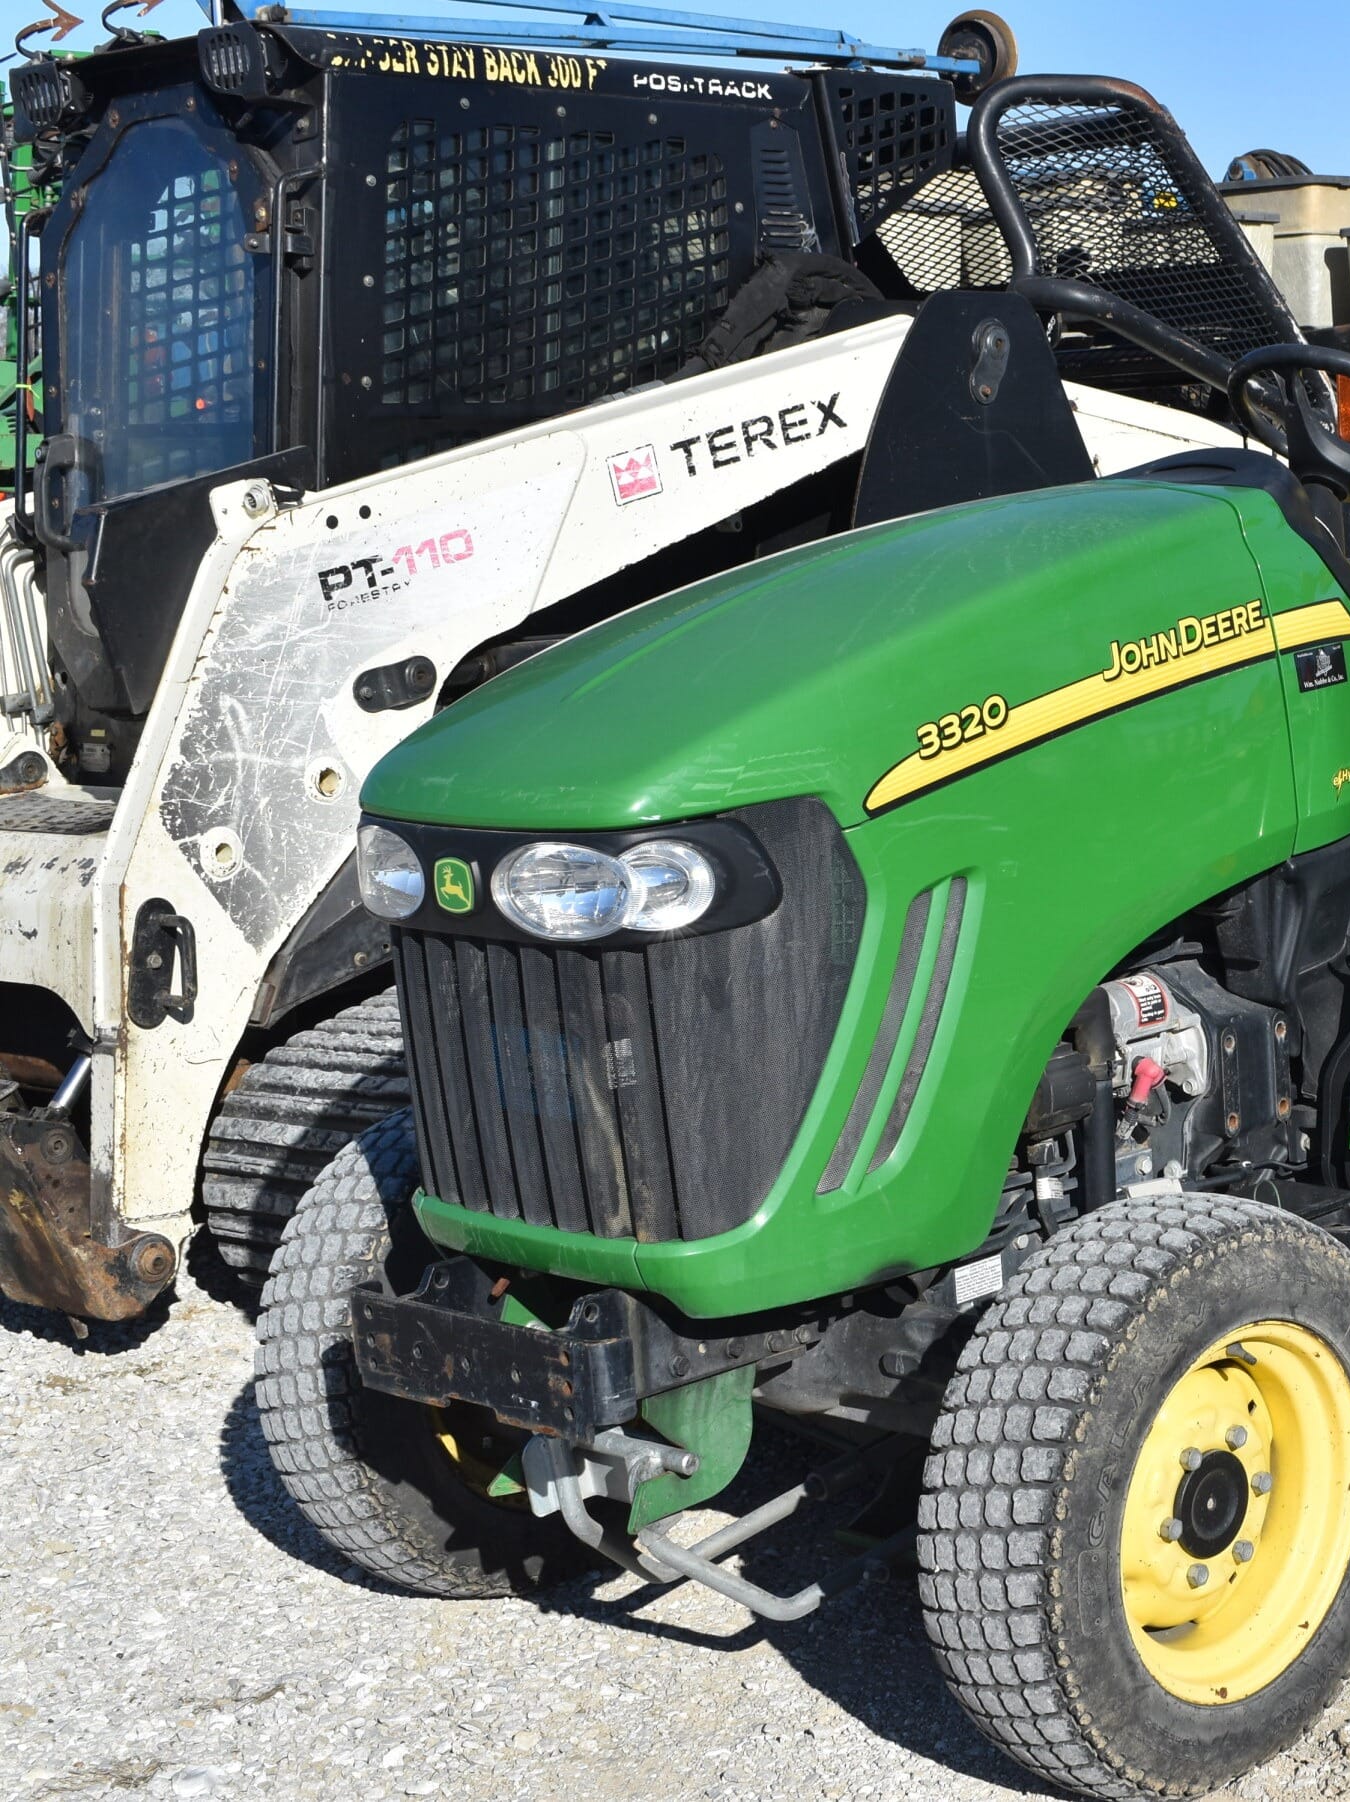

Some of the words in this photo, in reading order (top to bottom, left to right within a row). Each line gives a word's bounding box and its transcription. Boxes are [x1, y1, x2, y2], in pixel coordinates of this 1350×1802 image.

[426, 43, 476, 79] STAY
[483, 48, 541, 85] BACK
[633, 73, 773, 99] POSI-TRACK
[670, 391, 847, 477] TEREX
[318, 529, 474, 601] PT-110
[1101, 627, 1181, 681] JOHN
[1179, 599, 1269, 655] DEERE
[917, 694, 1008, 759] 3320
